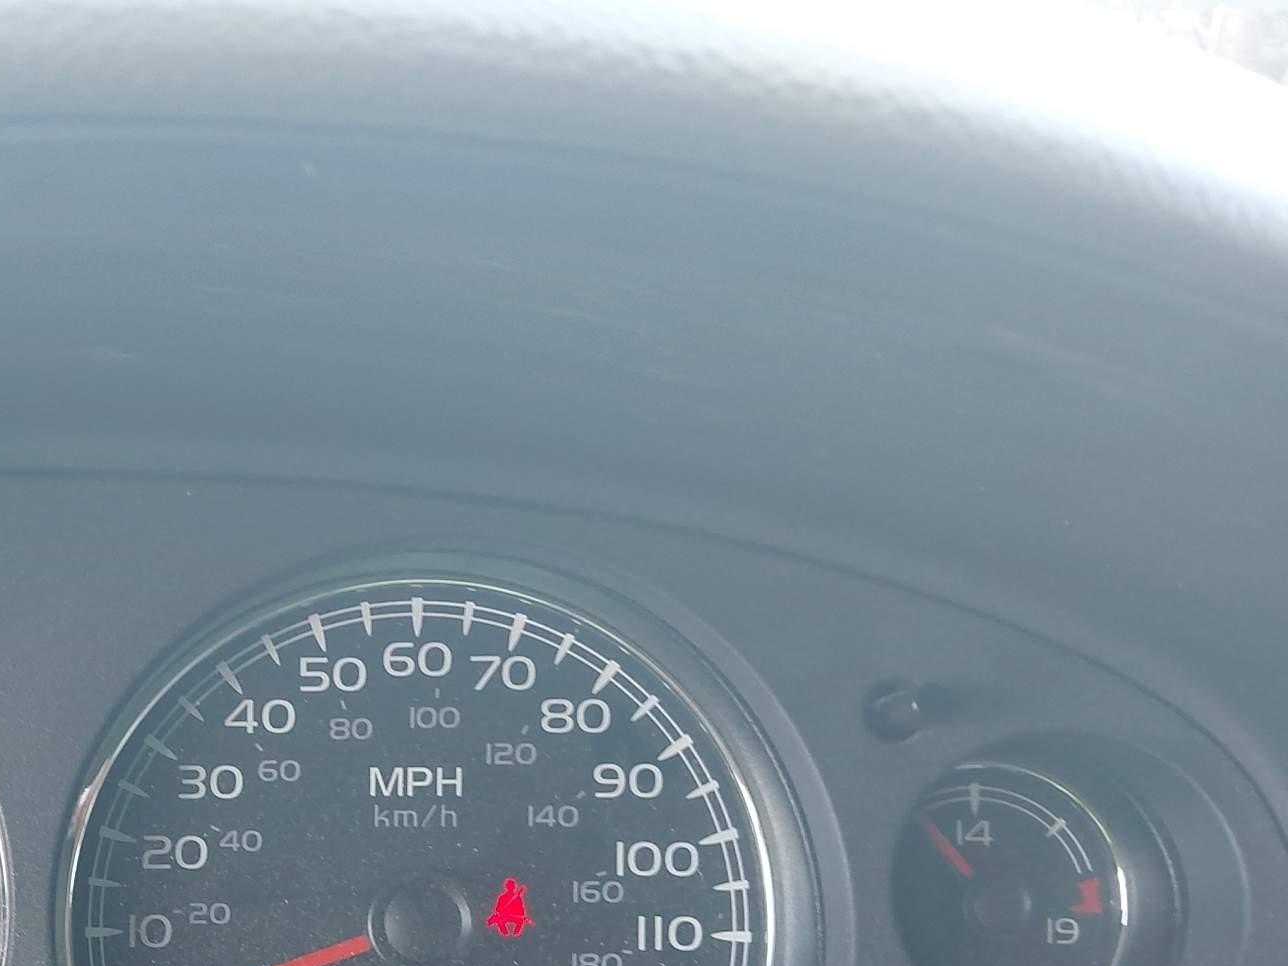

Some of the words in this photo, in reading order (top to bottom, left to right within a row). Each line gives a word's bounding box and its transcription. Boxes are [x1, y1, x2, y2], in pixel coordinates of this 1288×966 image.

[299, 657, 367, 692] 50
[384, 642, 452, 678] 60
[471, 656, 537, 692] 70
[224, 699, 296, 736] 40
[329, 718, 373, 741] 80
[408, 707, 460, 730] 100
[541, 698, 612, 735] 80
[485, 743, 537, 766] 120
[180, 764, 244, 800] 30
[257, 760, 301, 783] 60
[368, 767, 464, 797] MPH
[593, 763, 663, 799] 90
[372, 806, 458, 831] km/h
[527, 806, 579, 829] 140
[218, 829, 263, 852] 40
[956, 820, 993, 847] 14
[141, 836, 208, 871] 20
[615, 841, 699, 876] 100
[571, 882, 624, 904] 160
[188, 904, 231, 926] 20
[128, 915, 173, 949] 10
[636, 918, 703, 952] 110
[1046, 918, 1080, 945] 19
